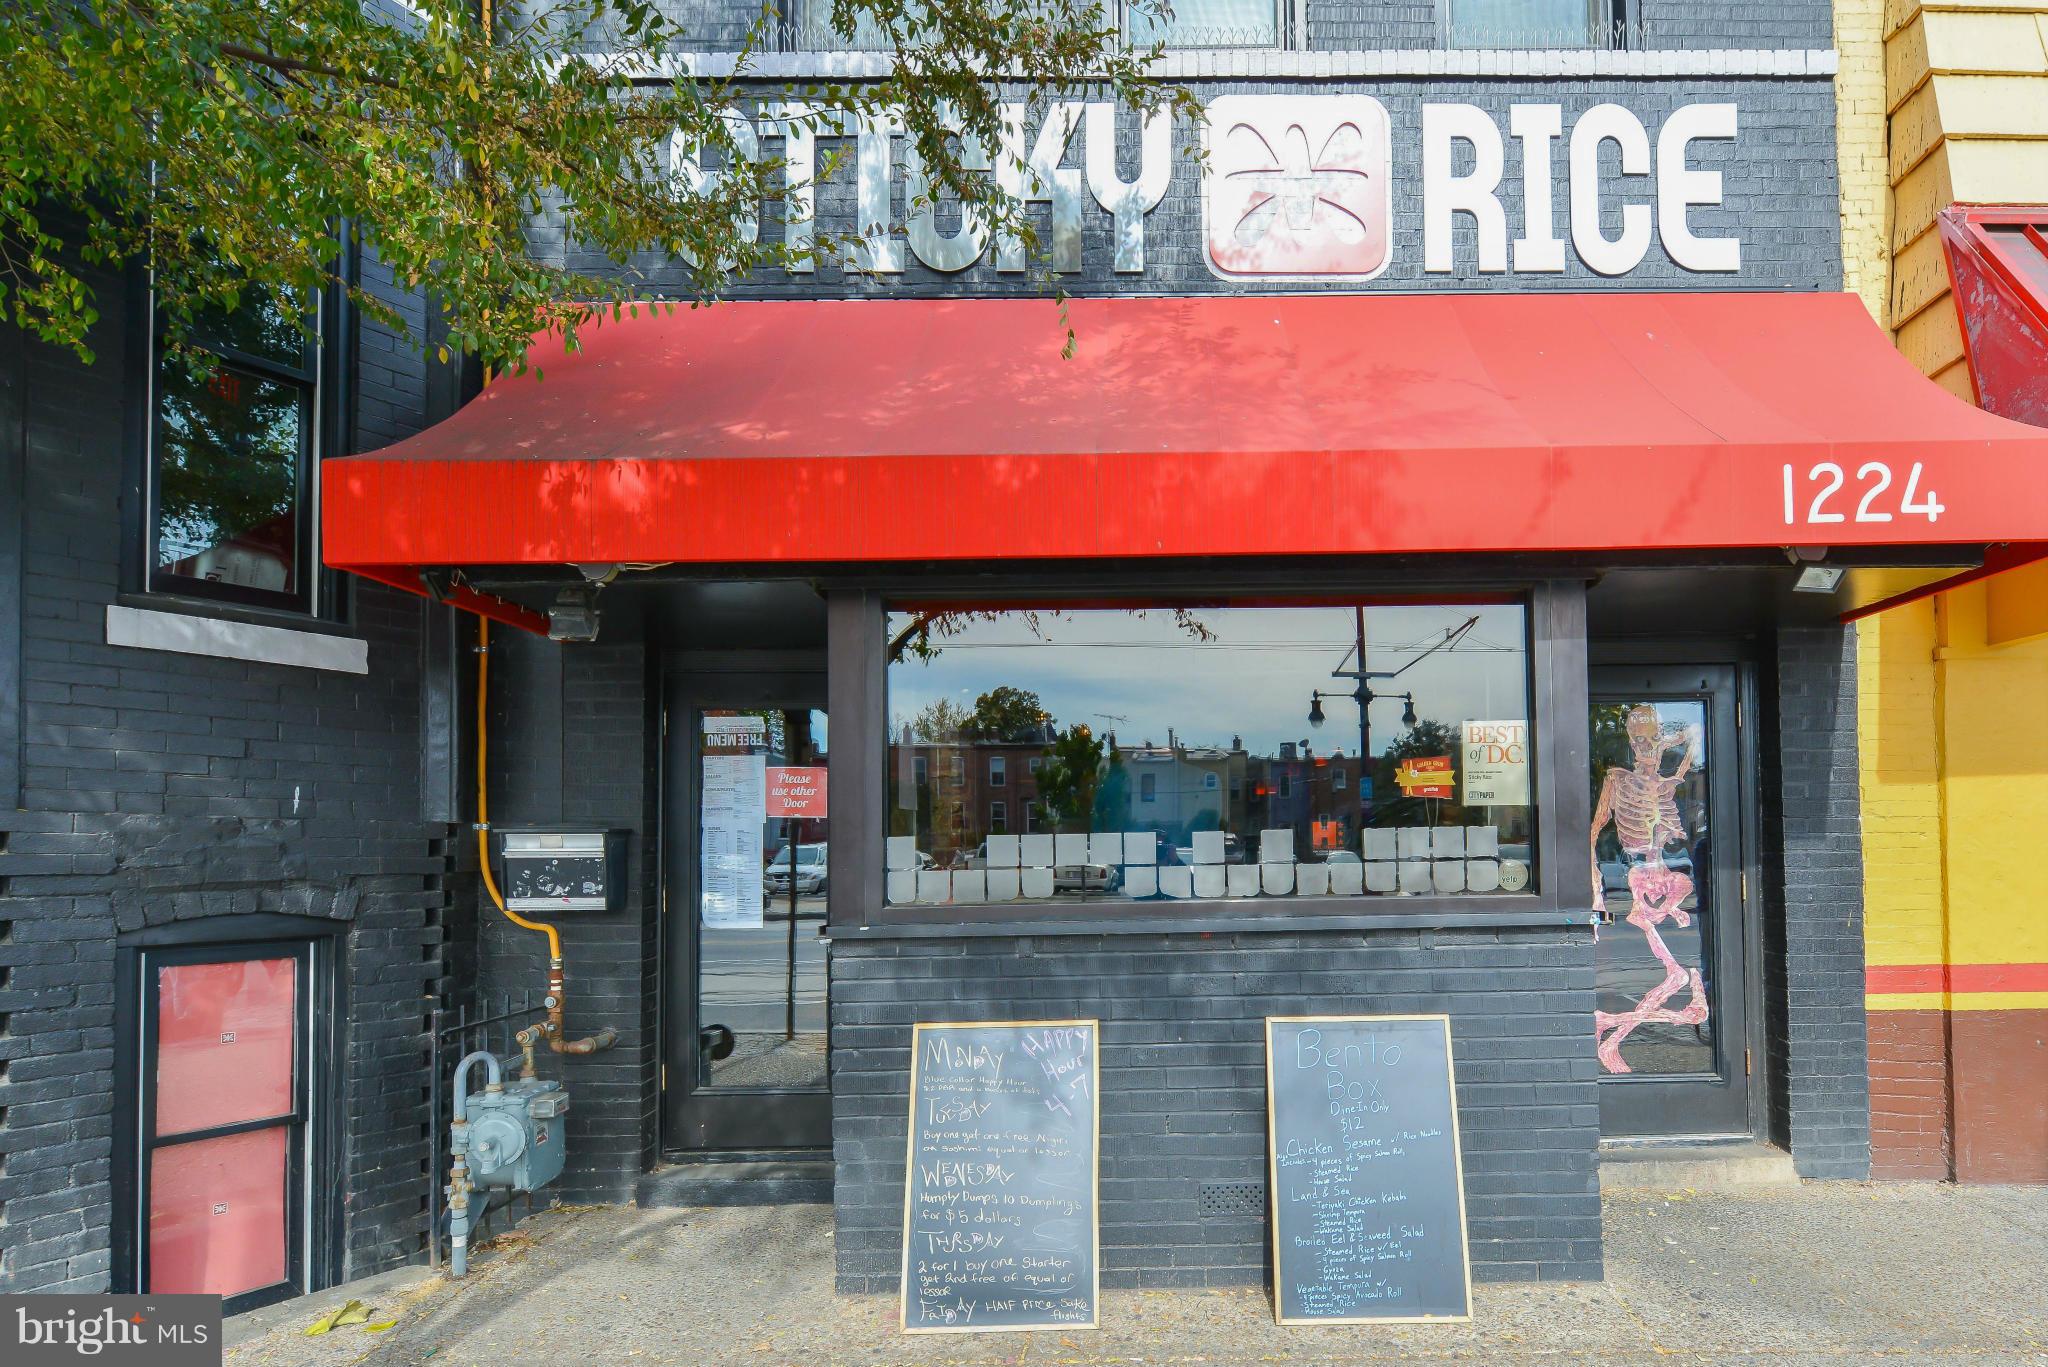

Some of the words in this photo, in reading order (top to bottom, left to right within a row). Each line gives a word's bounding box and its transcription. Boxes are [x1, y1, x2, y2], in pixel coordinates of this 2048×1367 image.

[669, 100, 1173, 273] STICKY
[1422, 102, 1741, 276] RICE
[1782, 461, 1945, 525] 1224
[706, 732, 736, 747] MENU
[735, 732, 763, 747] FREE
[1468, 725, 1524, 744] BEST
[1469, 745, 1486, 763] of
[777, 773, 811, 785] Please
[772, 787, 789, 796] use
[790, 784, 817, 797] other
[783, 798, 808, 809] Door
[1501, 876, 1518, 884] yelp
[1297, 1028, 1402, 1070] Bento
[1326, 1070, 1384, 1101] Box
[1370, 1100, 1391, 1114] Only
[1340, 1115, 1366, 1133] $12
[1286, 1137, 1334, 1157] Chicken
[1342, 1134, 1383, 1152] Sesame
[1292, 1187, 1318, 1202] Land
[1004, 1194, 1015, 1205] 10
[1020, 1194, 1082, 1216] Dumplings
[974, 1208, 1023, 1227] dollars
[1331, 1234, 1346, 1245] Eel
[1400, 1223, 1425, 1238] Salad
[1358, 1244, 1376, 1254] Rice
[931, 1261, 949, 1272] for
[965, 1260, 988, 1275] buy
[991, 1257, 1017, 1268] one
[920, 1274, 940, 1287] get
[944, 1272, 968, 1284] 2nd
[971, 1273, 998, 1284] free
[1024, 1273, 1057, 1287] equal
[1060, 1272, 1076, 1284] or
[1387, 1285, 1403, 1299] Roll
[985, 1300, 1017, 1313] HALF
[1339, 1299, 1357, 1308] Rice
